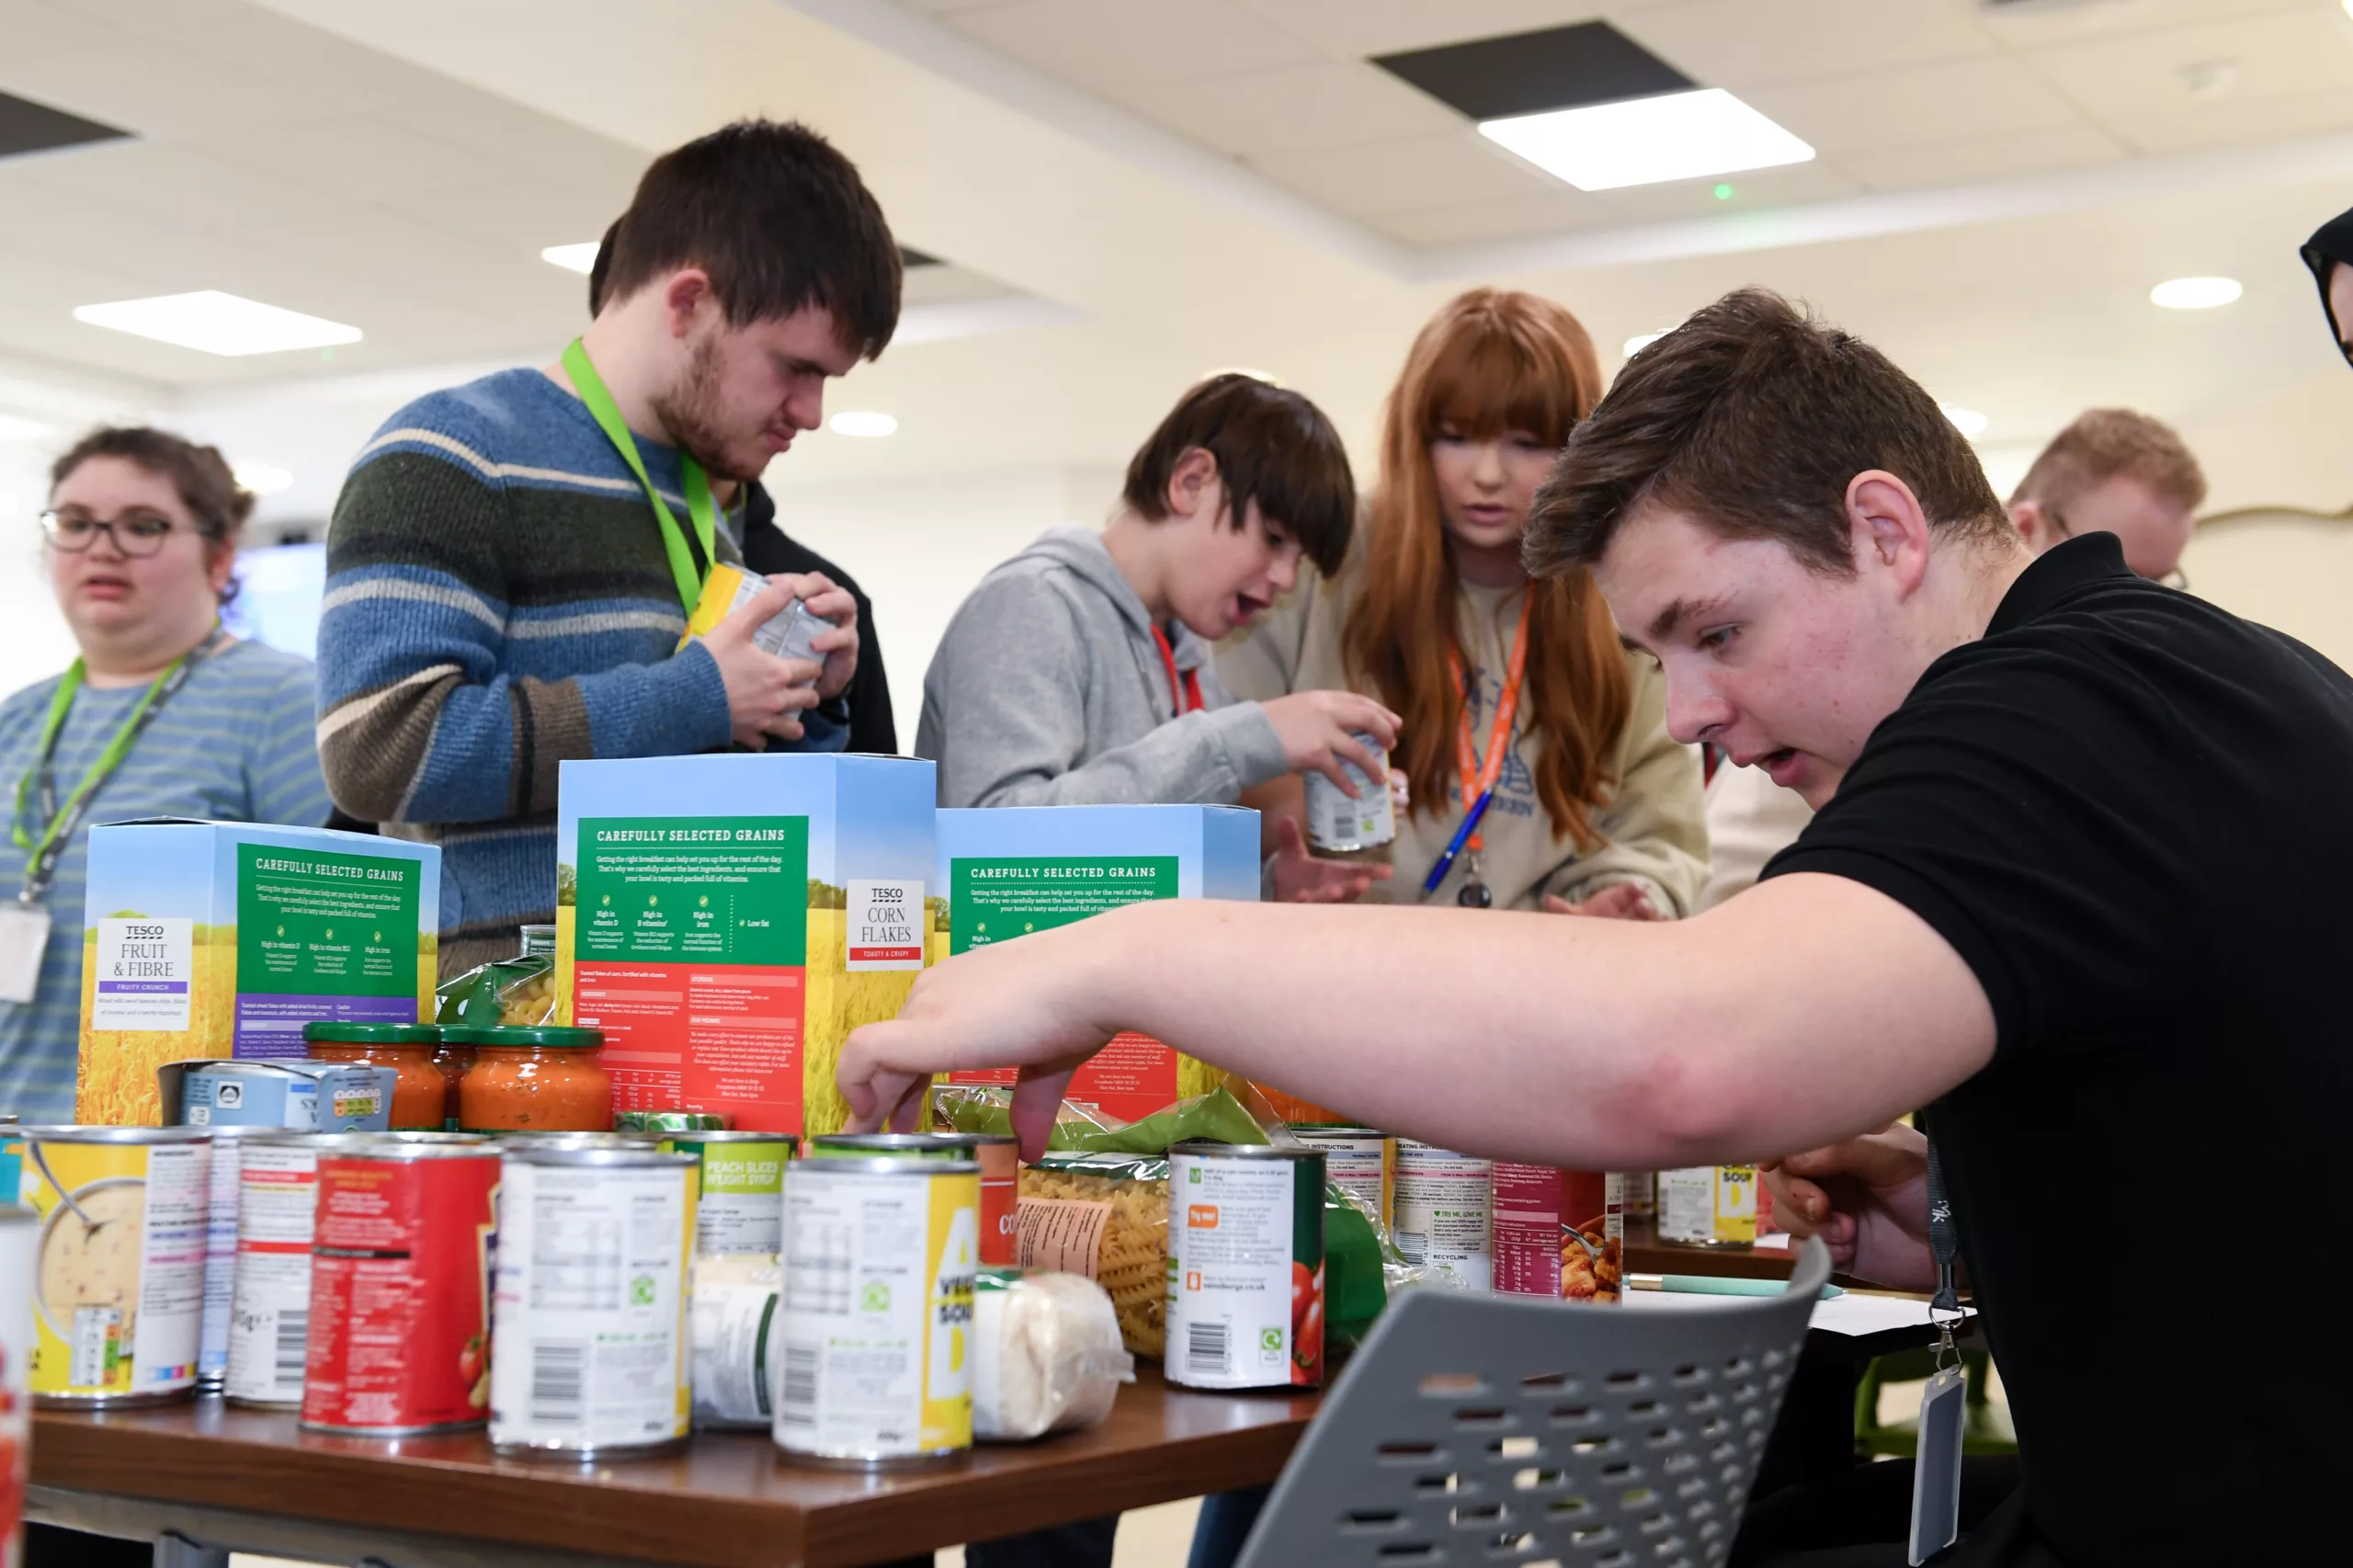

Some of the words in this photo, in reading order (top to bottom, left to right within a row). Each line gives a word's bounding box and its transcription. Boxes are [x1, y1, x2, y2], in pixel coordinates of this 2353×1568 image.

[597, 830, 665, 842] CAREFULLY
[668, 829, 731, 842] SELECTED
[735, 829, 785, 841] GRAINS
[256, 858, 313, 873] CAREFULLY
[315, 864, 364, 878] SELECTED
[367, 869, 404, 881] GRAINS
[971, 868, 1040, 878] CAREFULLY
[1043, 868, 1104, 878] SELECTED
[1108, 867, 1155, 878] GRAINS
[871, 888, 904, 898] TESCO
[868, 907, 906, 923] CORN
[126, 926, 165, 935] TESCO
[861, 926, 912, 942] FLAKES
[121, 944, 167, 958] FRUIT
[114, 961, 124, 976] &
[129, 961, 174, 976] FIBRE
[706, 1161, 745, 1174] PEACH
[746, 1161, 779, 1174] SLICES
[1722, 1172, 1752, 1182] SOUP
[1190, 1210, 1201, 1222] Try
